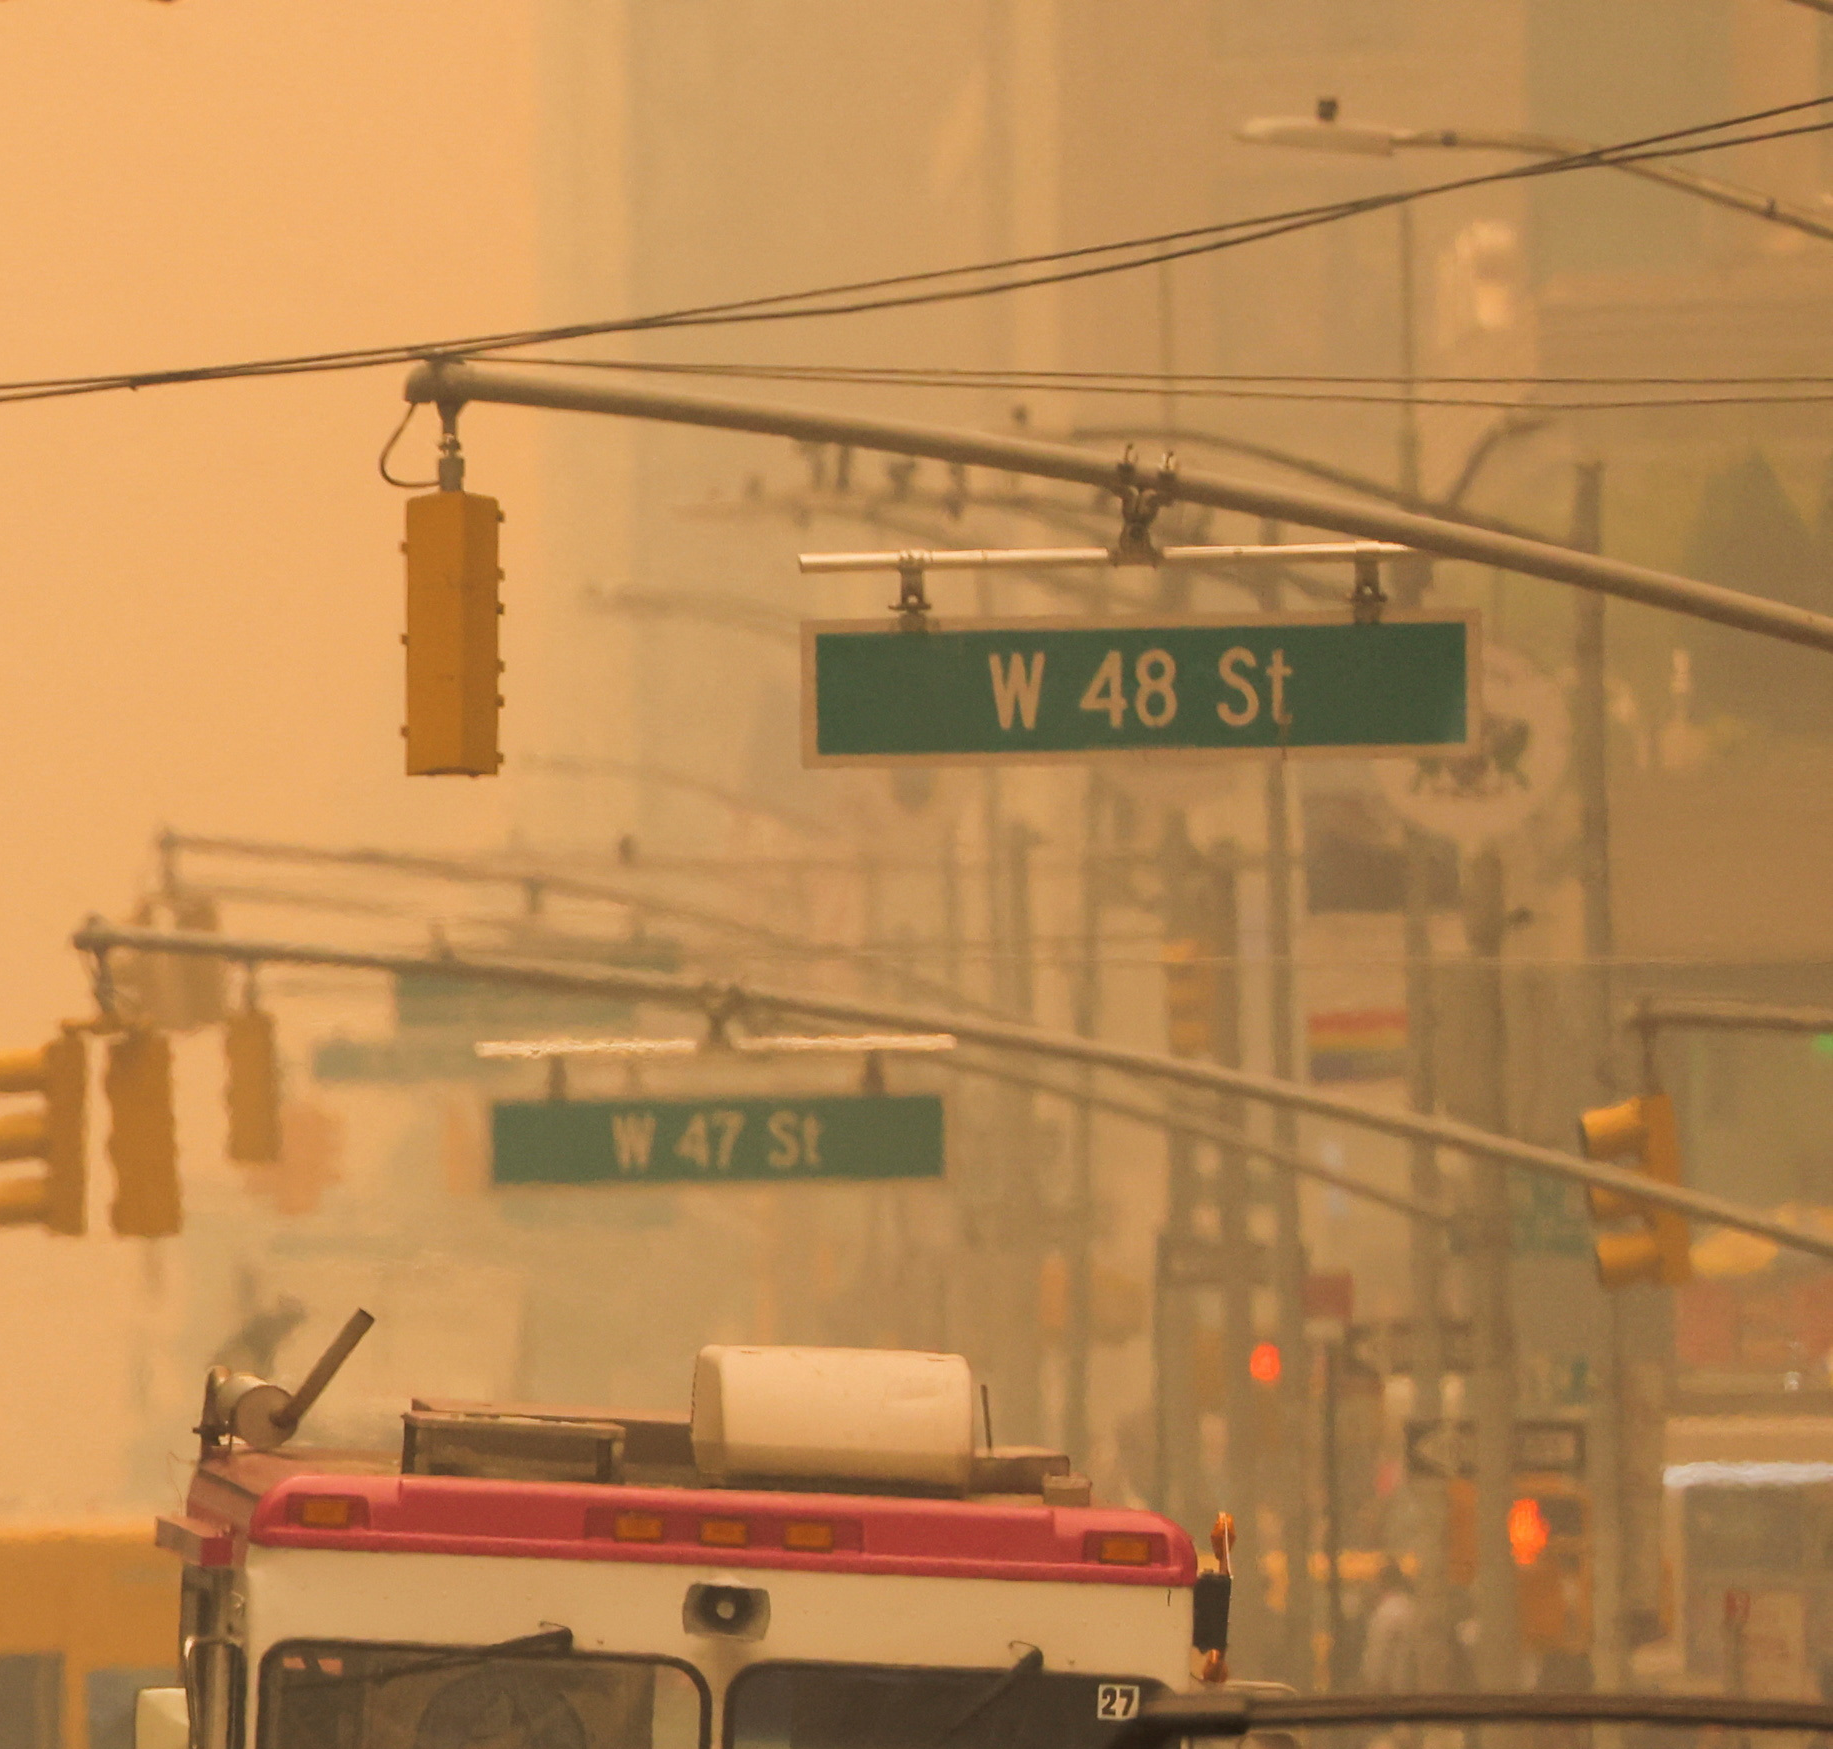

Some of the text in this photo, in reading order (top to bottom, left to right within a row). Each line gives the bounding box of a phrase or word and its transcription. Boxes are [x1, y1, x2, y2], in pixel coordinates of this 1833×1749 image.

[988, 646, 1294, 730] W 48 St
[612, 1110, 821, 1169] W 47 St
[1101, 1687, 1133, 1716] 27
